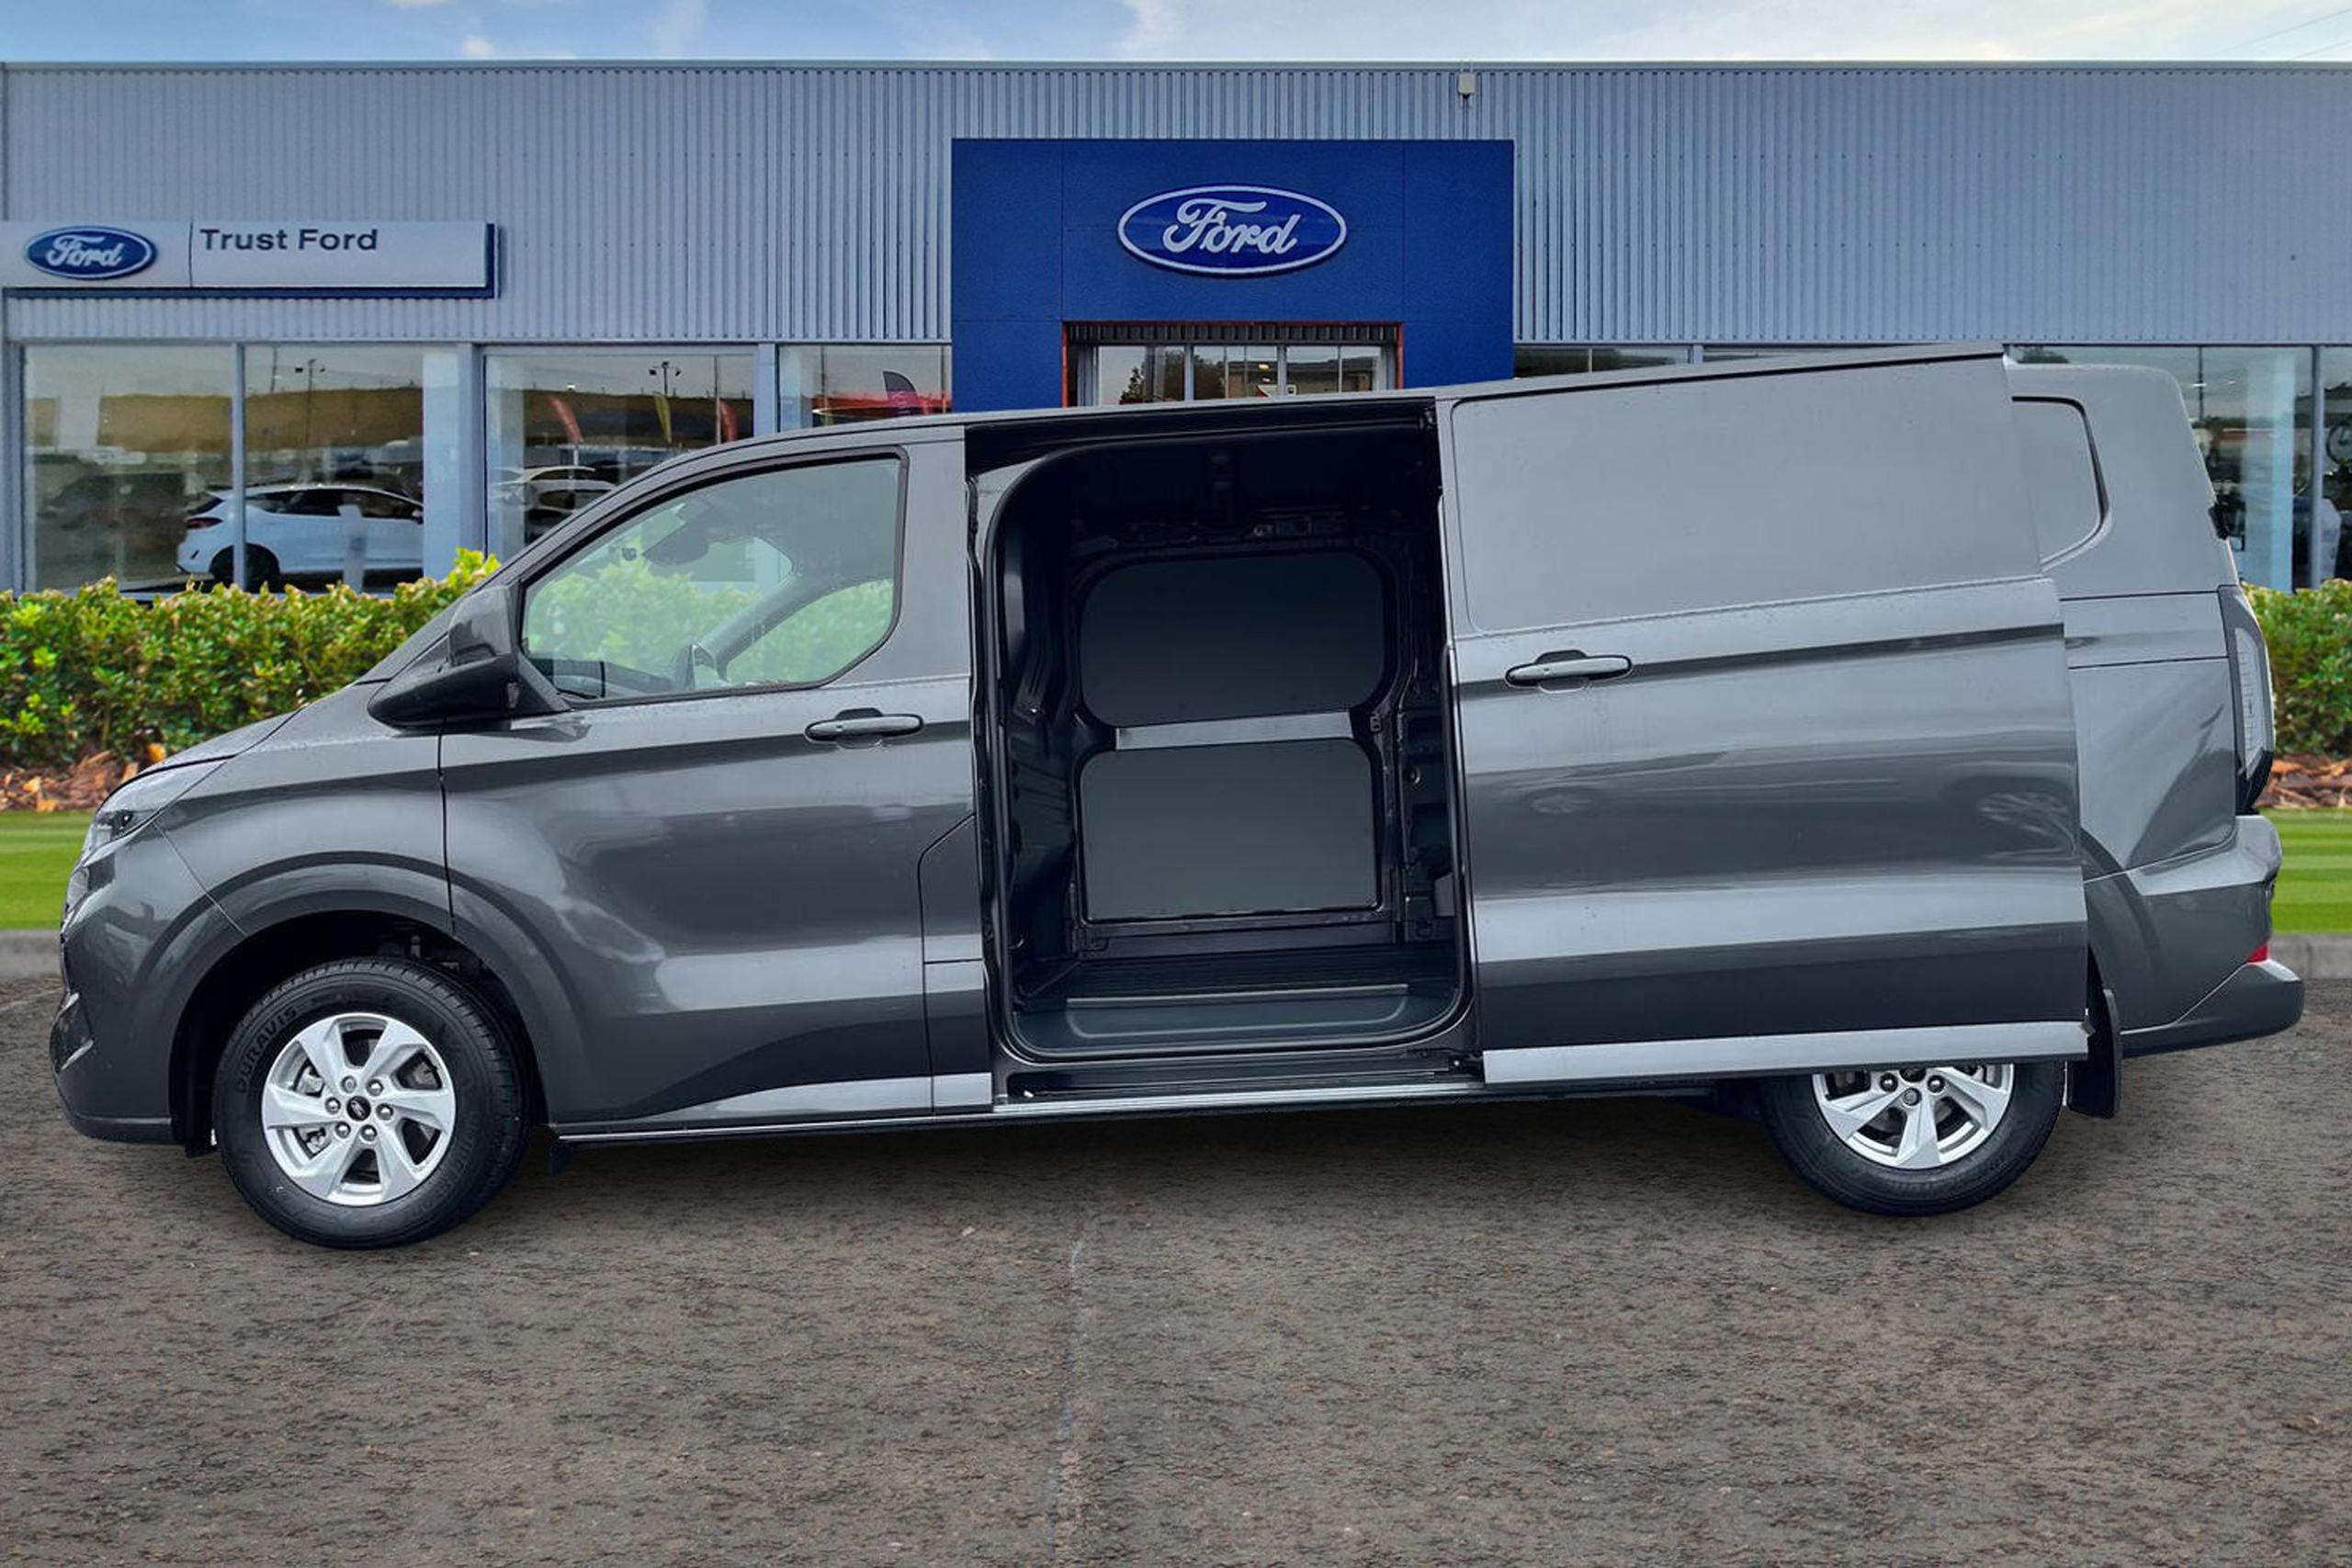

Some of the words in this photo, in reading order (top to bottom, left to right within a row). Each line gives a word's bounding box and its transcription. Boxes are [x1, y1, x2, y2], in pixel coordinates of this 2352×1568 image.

[199, 228, 288, 251] Trust
[298, 228, 379, 251] Ford
[1162, 197, 1302, 254] Ford
[46, 234, 124, 266] Ford
[237, 1006, 299, 1093] DURAVIS
